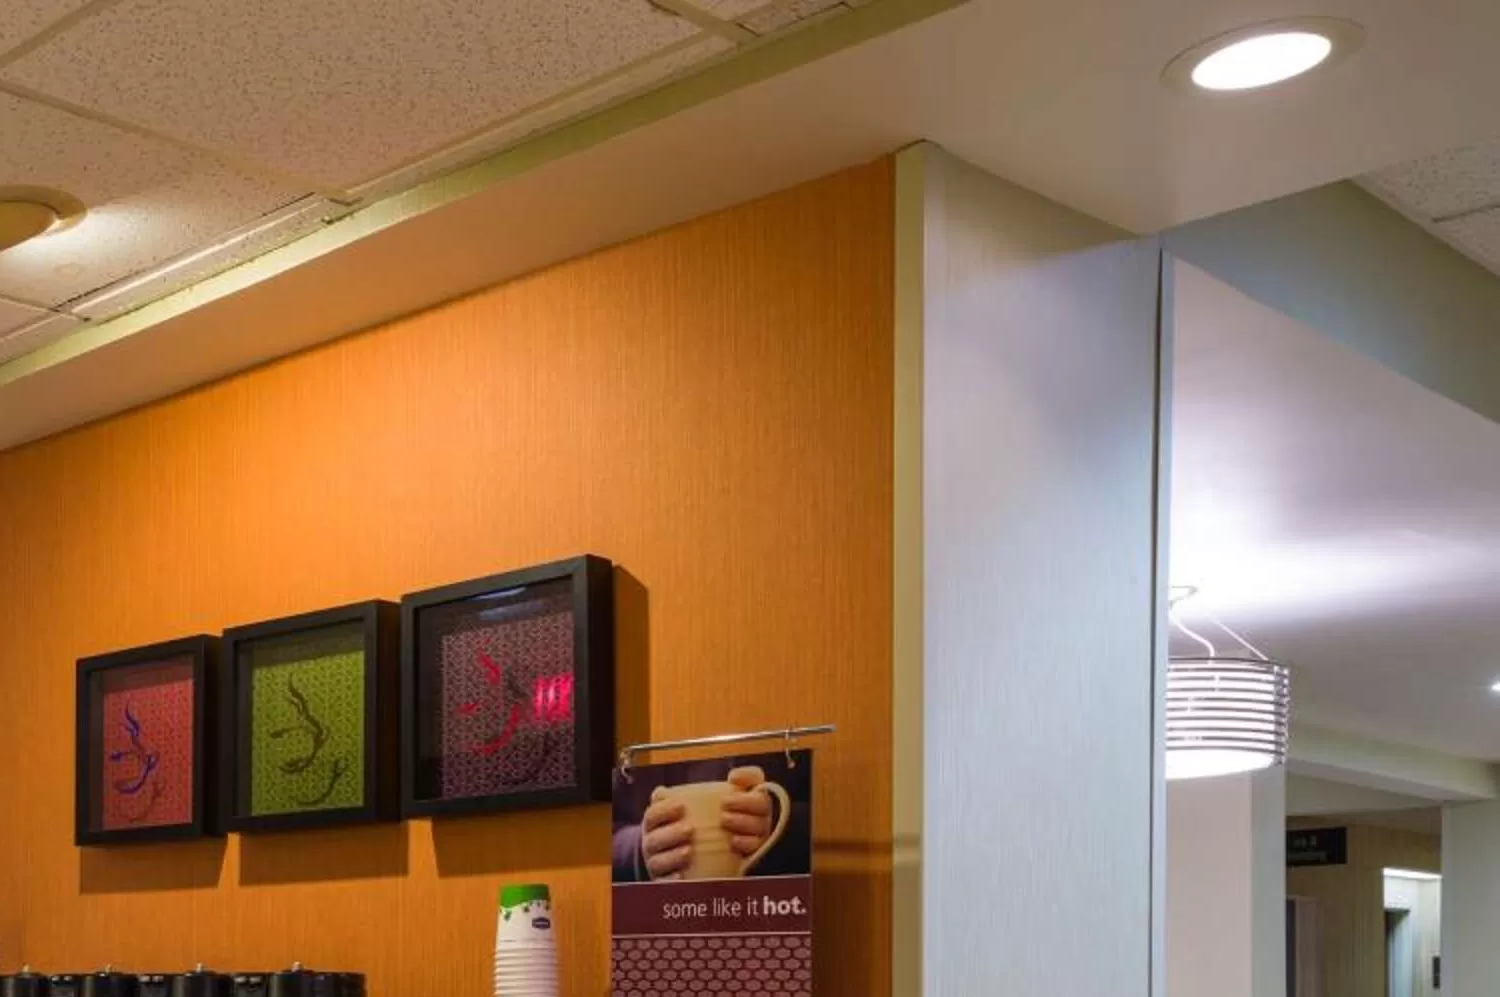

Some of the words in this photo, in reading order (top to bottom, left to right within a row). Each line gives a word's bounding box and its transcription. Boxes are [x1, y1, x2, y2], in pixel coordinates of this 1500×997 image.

[662, 901, 707, 919] some
[713, 897, 741, 917] like
[747, 896, 759, 916] it
[763, 895, 807, 915] hot.
